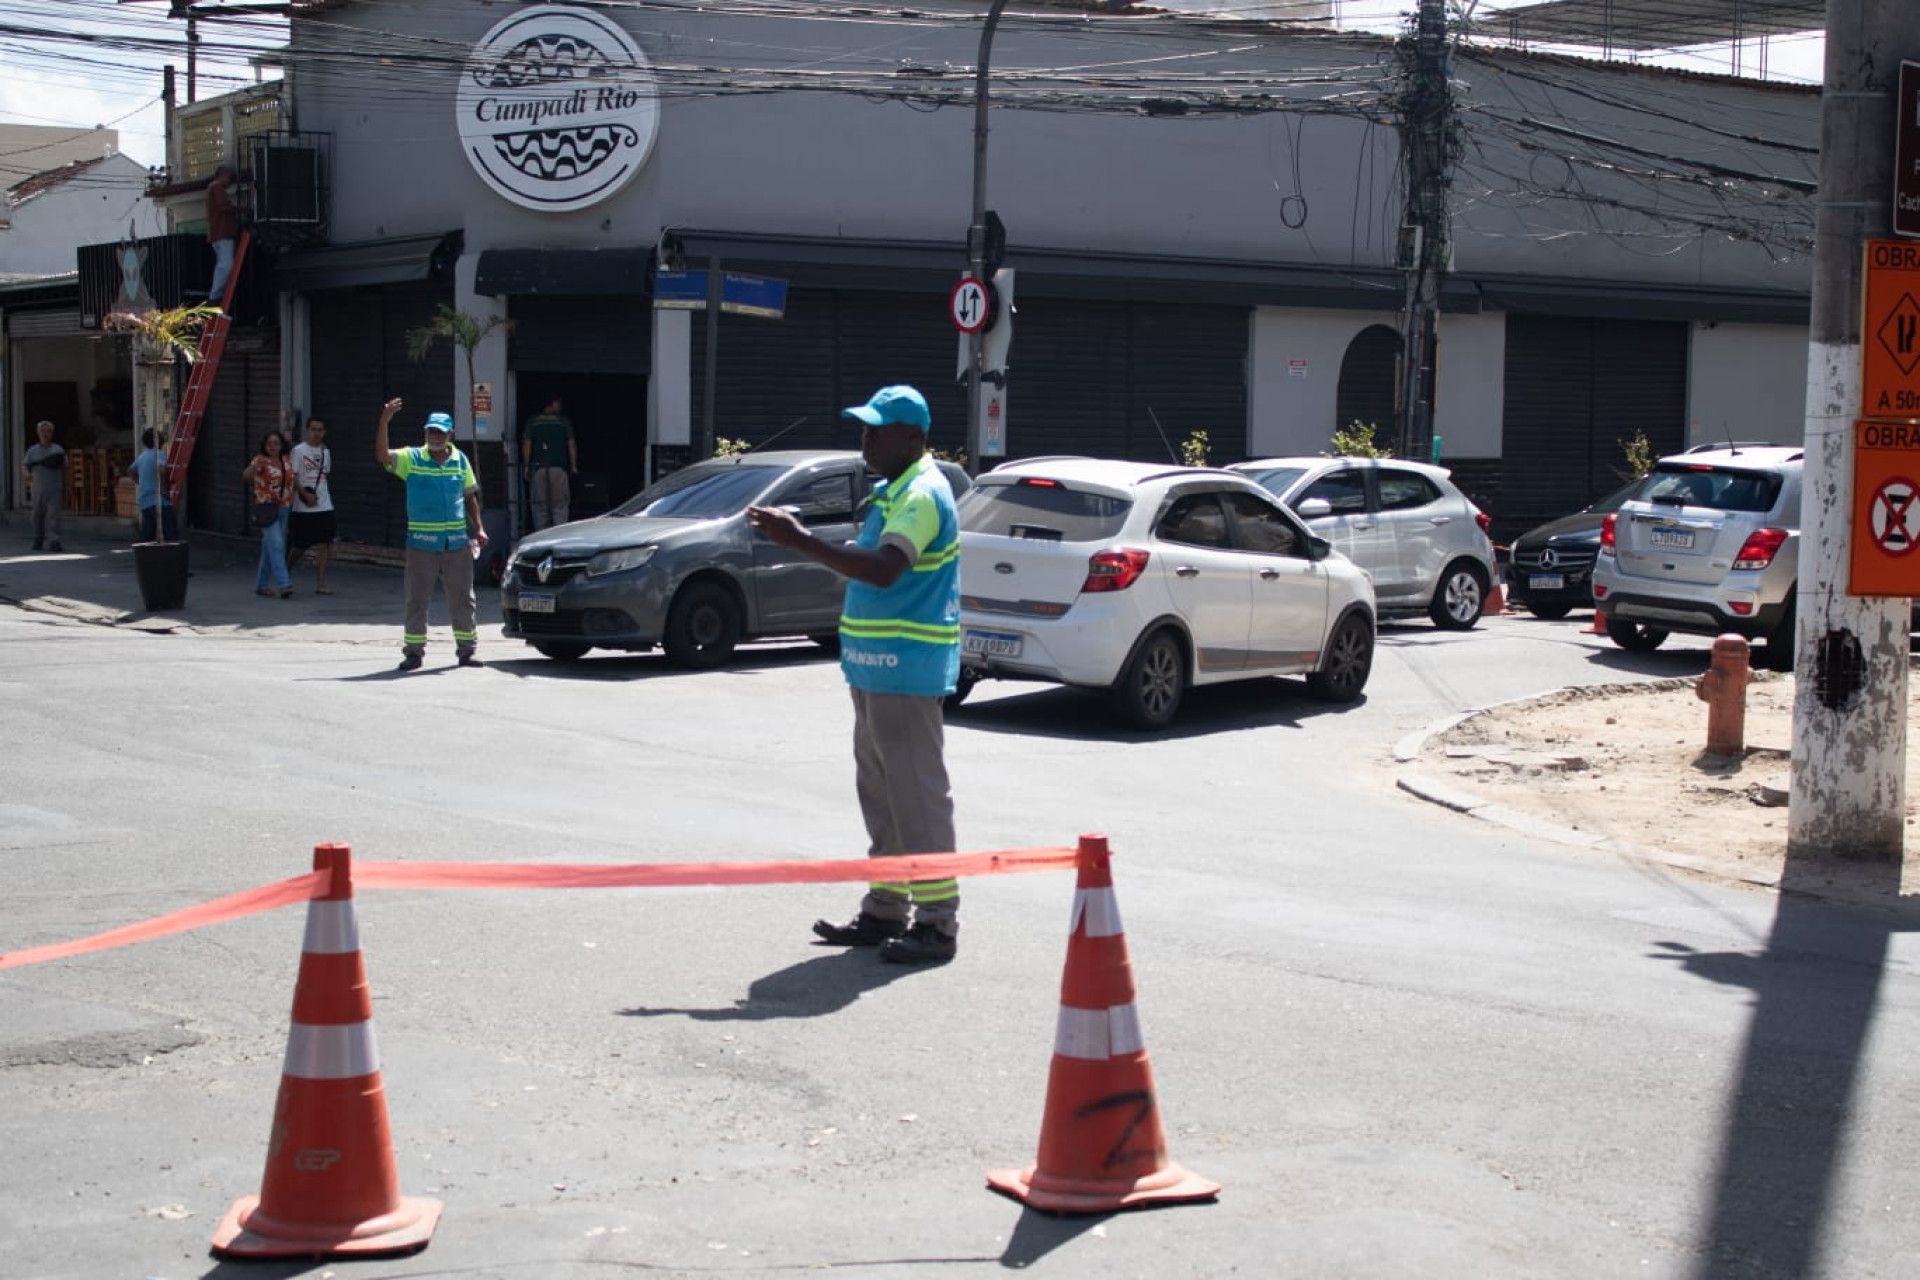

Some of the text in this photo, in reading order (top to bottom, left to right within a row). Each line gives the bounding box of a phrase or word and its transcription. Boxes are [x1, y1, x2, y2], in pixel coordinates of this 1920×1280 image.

[475, 85, 638, 125] Cumpadi Rio
[1875, 246, 1920, 268] OBR
[1878, 390, 1891, 409] A
